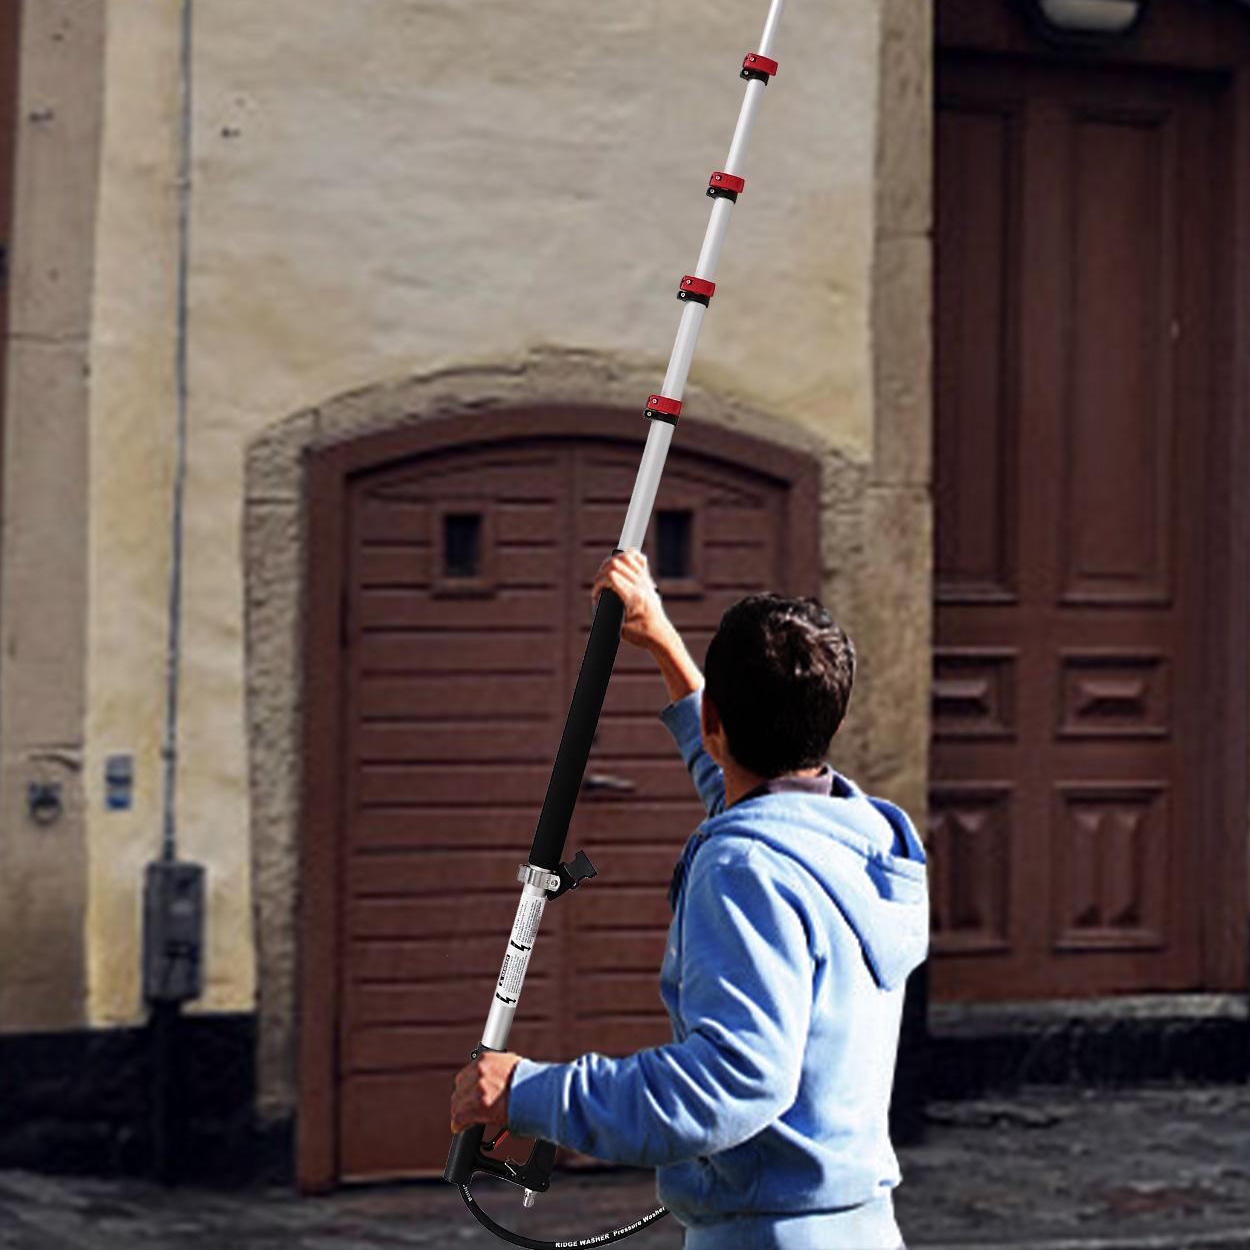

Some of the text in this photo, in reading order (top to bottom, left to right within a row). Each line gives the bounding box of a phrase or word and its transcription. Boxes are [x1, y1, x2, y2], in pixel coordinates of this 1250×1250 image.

[579, 1233, 610, 1246] WASHER
[613, 1220, 642, 1237] Pressure
[642, 1206, 666, 1223] Washer
